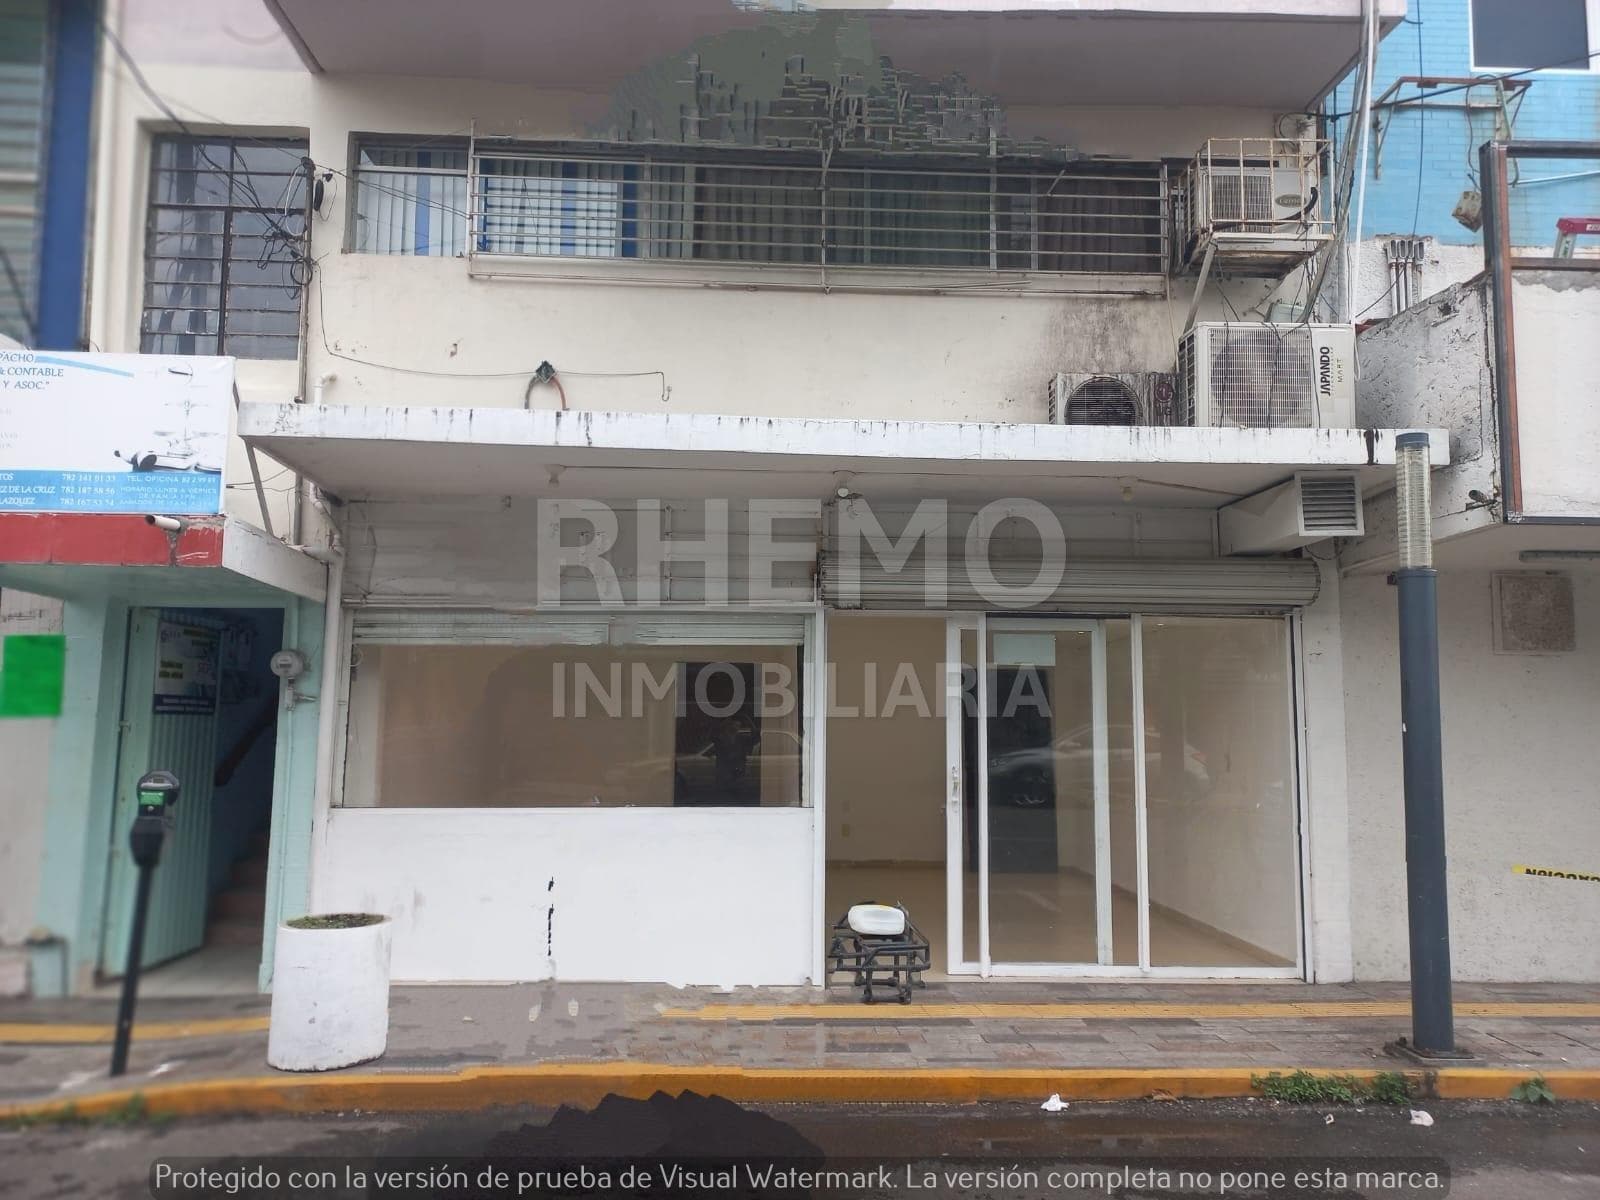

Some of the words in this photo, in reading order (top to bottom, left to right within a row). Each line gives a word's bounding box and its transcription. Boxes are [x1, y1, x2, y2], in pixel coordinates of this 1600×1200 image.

[7, 367, 64, 377] CONTABLE
[1319, 346, 1331, 397] JAPANDO
[3, 380, 10, 389] Y
[9, 485, 21, 494] DE
[21, 485, 33, 494] LA
[32, 485, 56, 495] CRUZ
